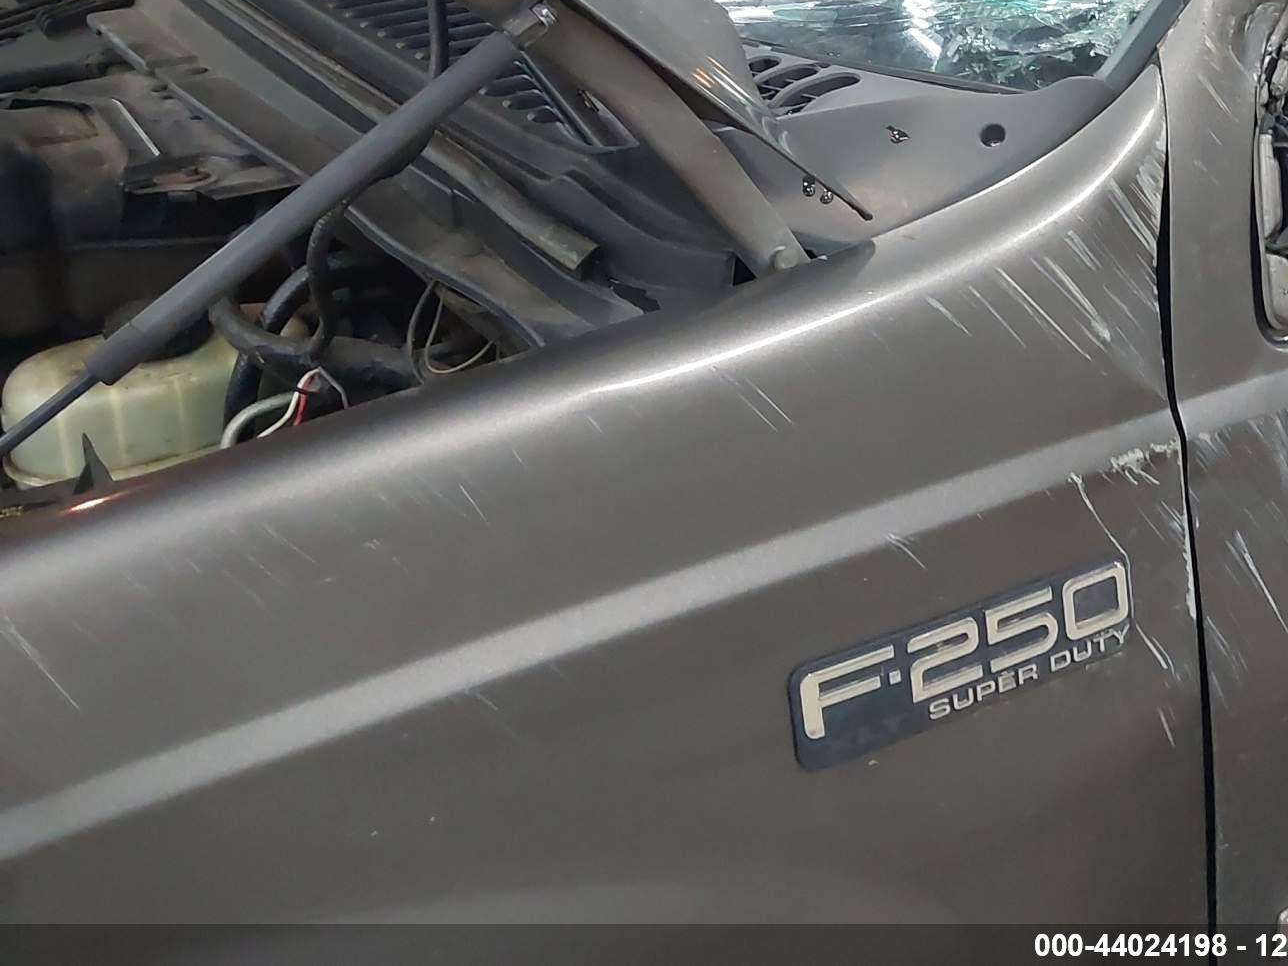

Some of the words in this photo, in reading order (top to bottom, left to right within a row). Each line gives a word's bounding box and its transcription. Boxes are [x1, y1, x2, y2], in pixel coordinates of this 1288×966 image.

[799, 561, 1130, 740] F-250
[928, 662, 1041, 720] SUPER
[1050, 622, 1132, 673] DUTY
